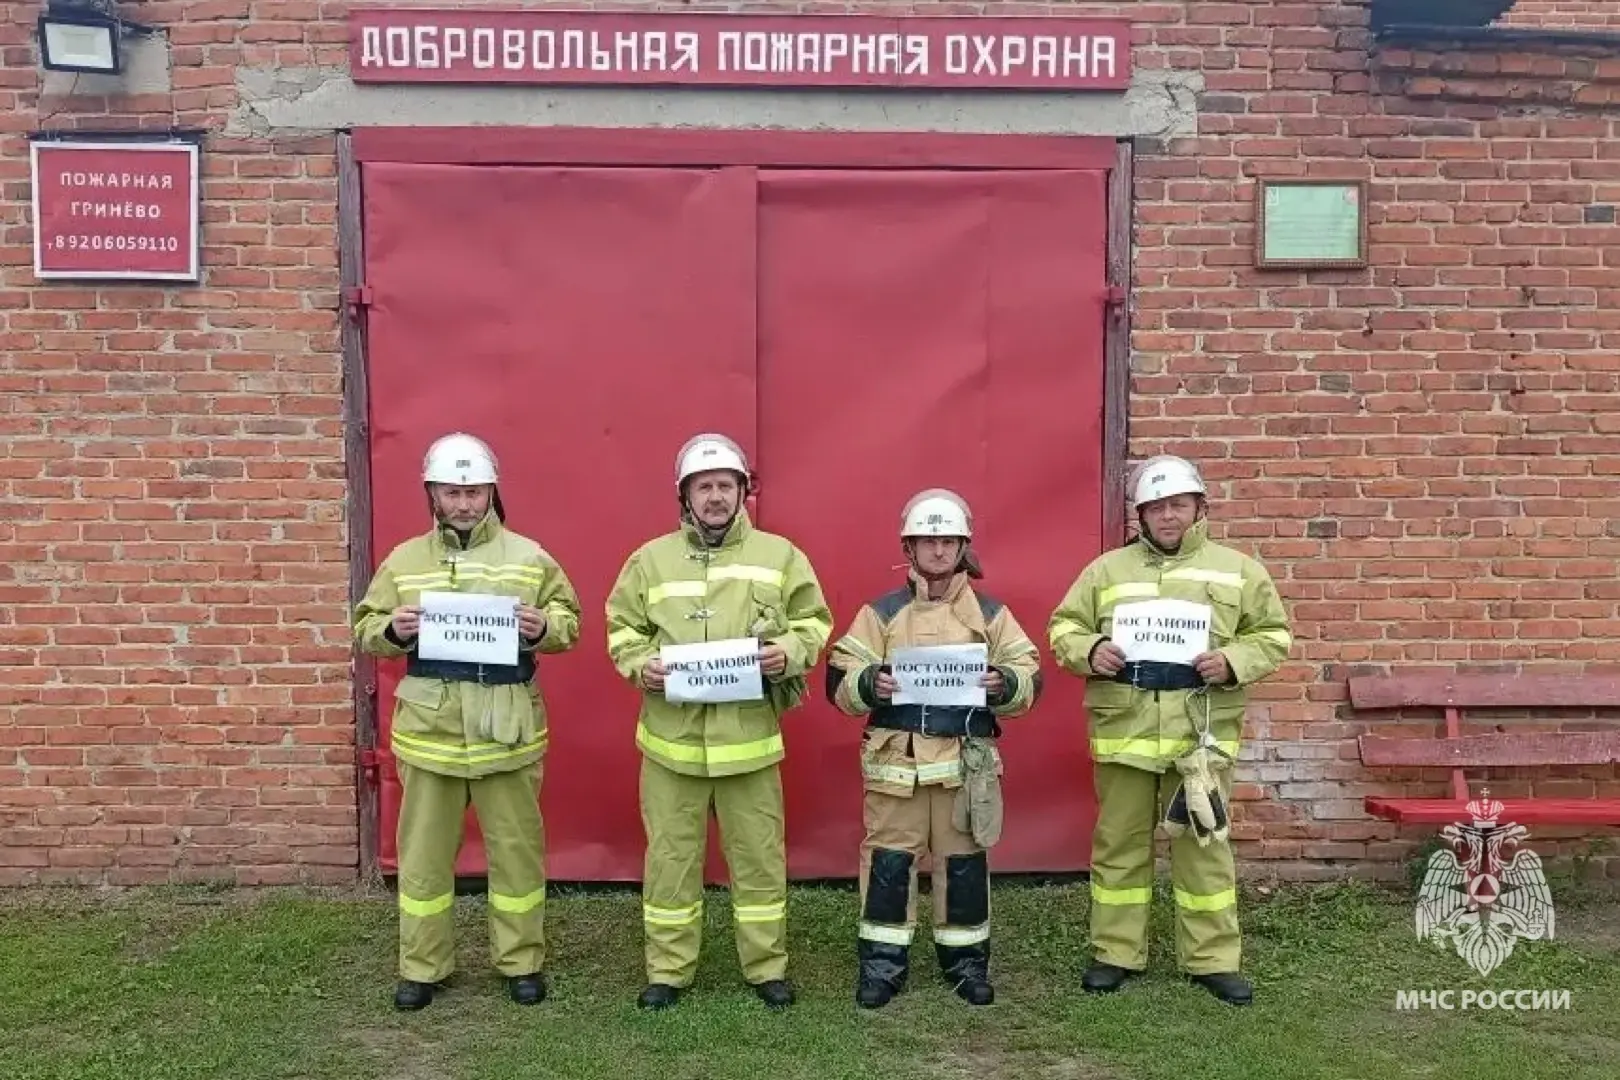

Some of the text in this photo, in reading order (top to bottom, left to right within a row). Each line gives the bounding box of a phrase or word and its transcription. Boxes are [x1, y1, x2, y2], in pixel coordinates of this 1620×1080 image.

[361, 26, 1116, 77] ДОБРОВОЛЬНАЯ ПОЖАРНАЯ ОХРАНА
[60, 172, 173, 189] ПОЖАРНАЯ
[71, 201, 161, 219] ГРИНЁВО
[444, 629, 497, 643] ОГОНЬ
[1134, 631, 1185, 644] ОГОНЬ
[687, 673, 740, 687] ОГОНЬ
[914, 678, 965, 688] ОГОНЬ
